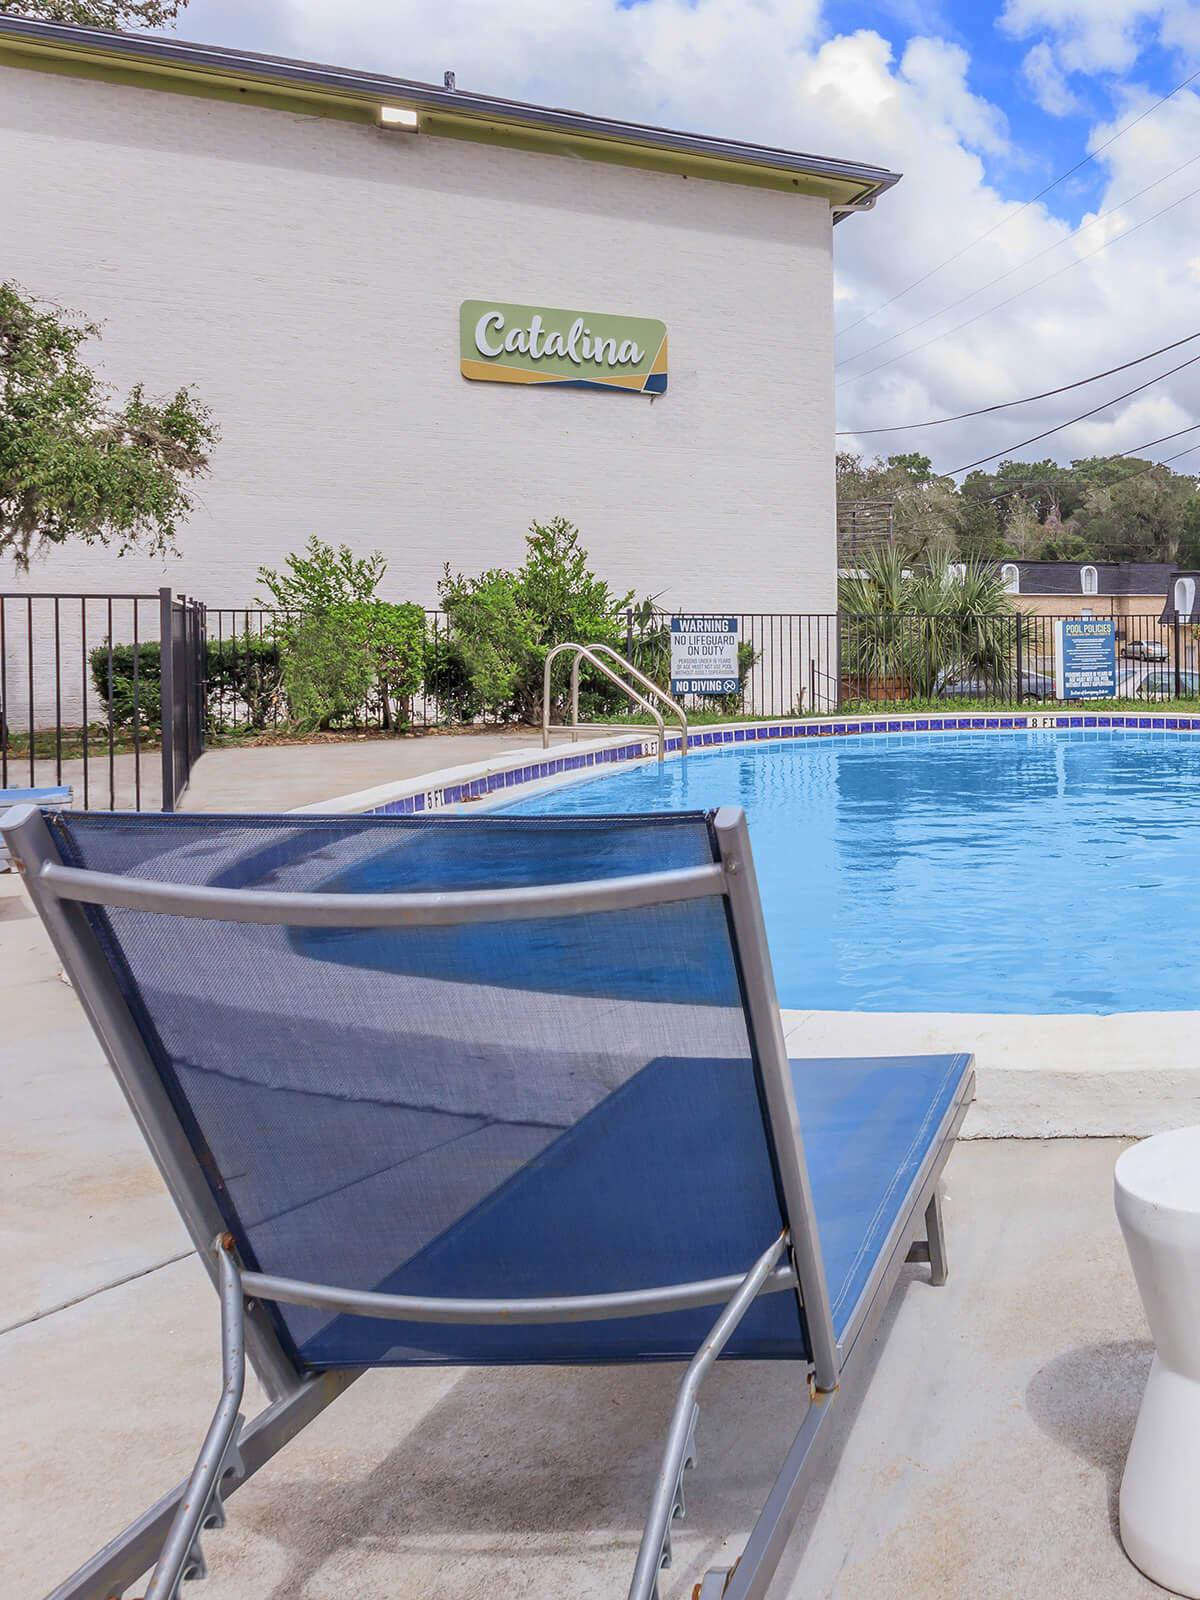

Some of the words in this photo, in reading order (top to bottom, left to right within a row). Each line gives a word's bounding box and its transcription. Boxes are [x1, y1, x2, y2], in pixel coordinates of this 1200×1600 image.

[475, 311, 645, 365] Catalina
[680, 620, 729, 632] WARNING
[1066, 624, 1082, 633] POOL
[1083, 624, 1112, 633] POLICIES
[674, 635, 687, 645] NO
[689, 635, 735, 645] LIFEGUARD
[688, 646, 700, 656] ON
[702, 646, 724, 656] DUTY
[676, 681, 689, 692] NO
[691, 680, 722, 692] DIVING
[1031, 718, 1038, 728] 8
[1042, 718, 1055, 728] FT
[427, 791, 433, 809] 5
[434, 789, 443, 808] FT
